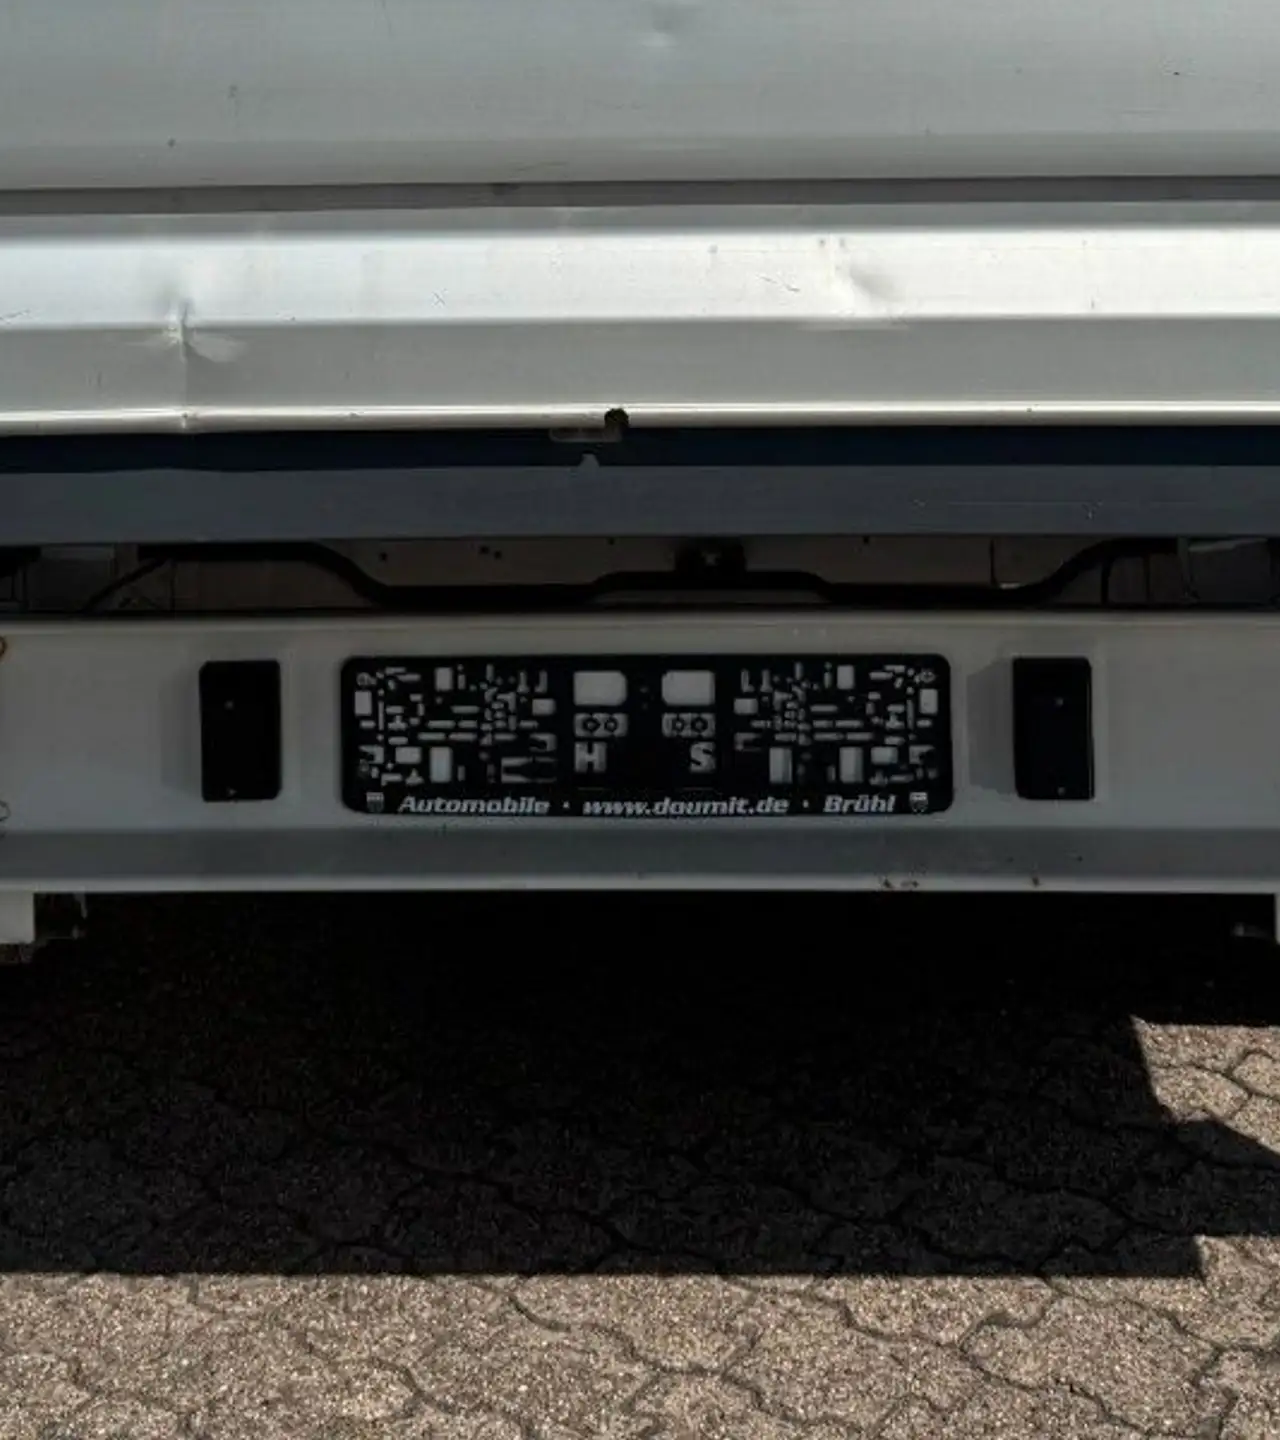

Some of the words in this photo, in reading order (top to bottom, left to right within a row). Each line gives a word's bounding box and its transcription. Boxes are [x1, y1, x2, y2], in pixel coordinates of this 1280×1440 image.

[398, 795, 550, 814] Automobile
[582, 795, 790, 816] www.doumit.de
[822, 793, 897, 813] Brühl
